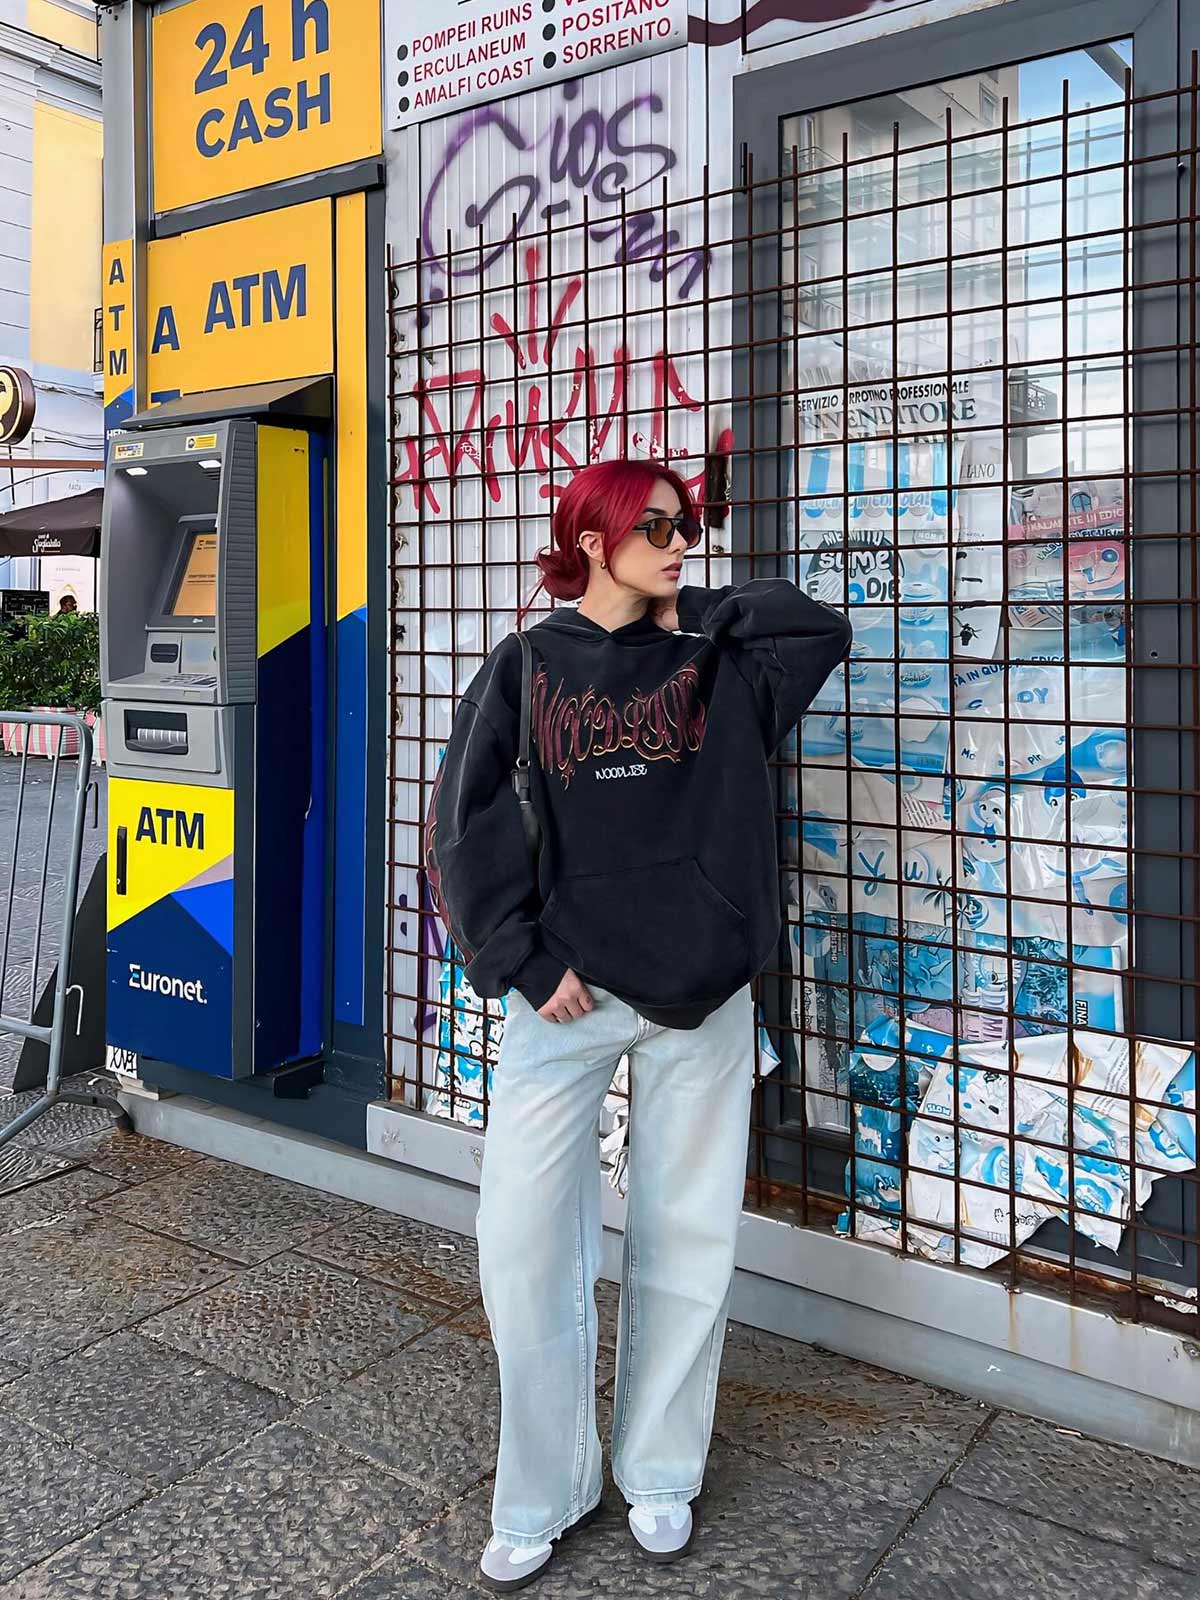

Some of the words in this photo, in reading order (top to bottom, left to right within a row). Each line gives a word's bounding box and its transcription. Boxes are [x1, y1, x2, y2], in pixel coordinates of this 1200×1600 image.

[195, 4, 270, 95] 24
[291, 0, 330, 62] h
[412, 20, 476, 57] POMPEII
[481, 3, 533, 35] RUINS
[563, 18, 671, 64] SORRENTO
[414, 32, 526, 83] ERCULANEUM
[414, 77, 471, 110] AMALFI
[477, 58, 534, 90] COAST
[195, 72, 331, 158] CASH
[204, 263, 307, 335] ATM
[797, 394, 839, 412] SERVIZIO
[842, 388, 888, 406] RROTINO
[799, 398, 977, 430] RIVENDITORE
[135, 805, 205, 851] ATM
